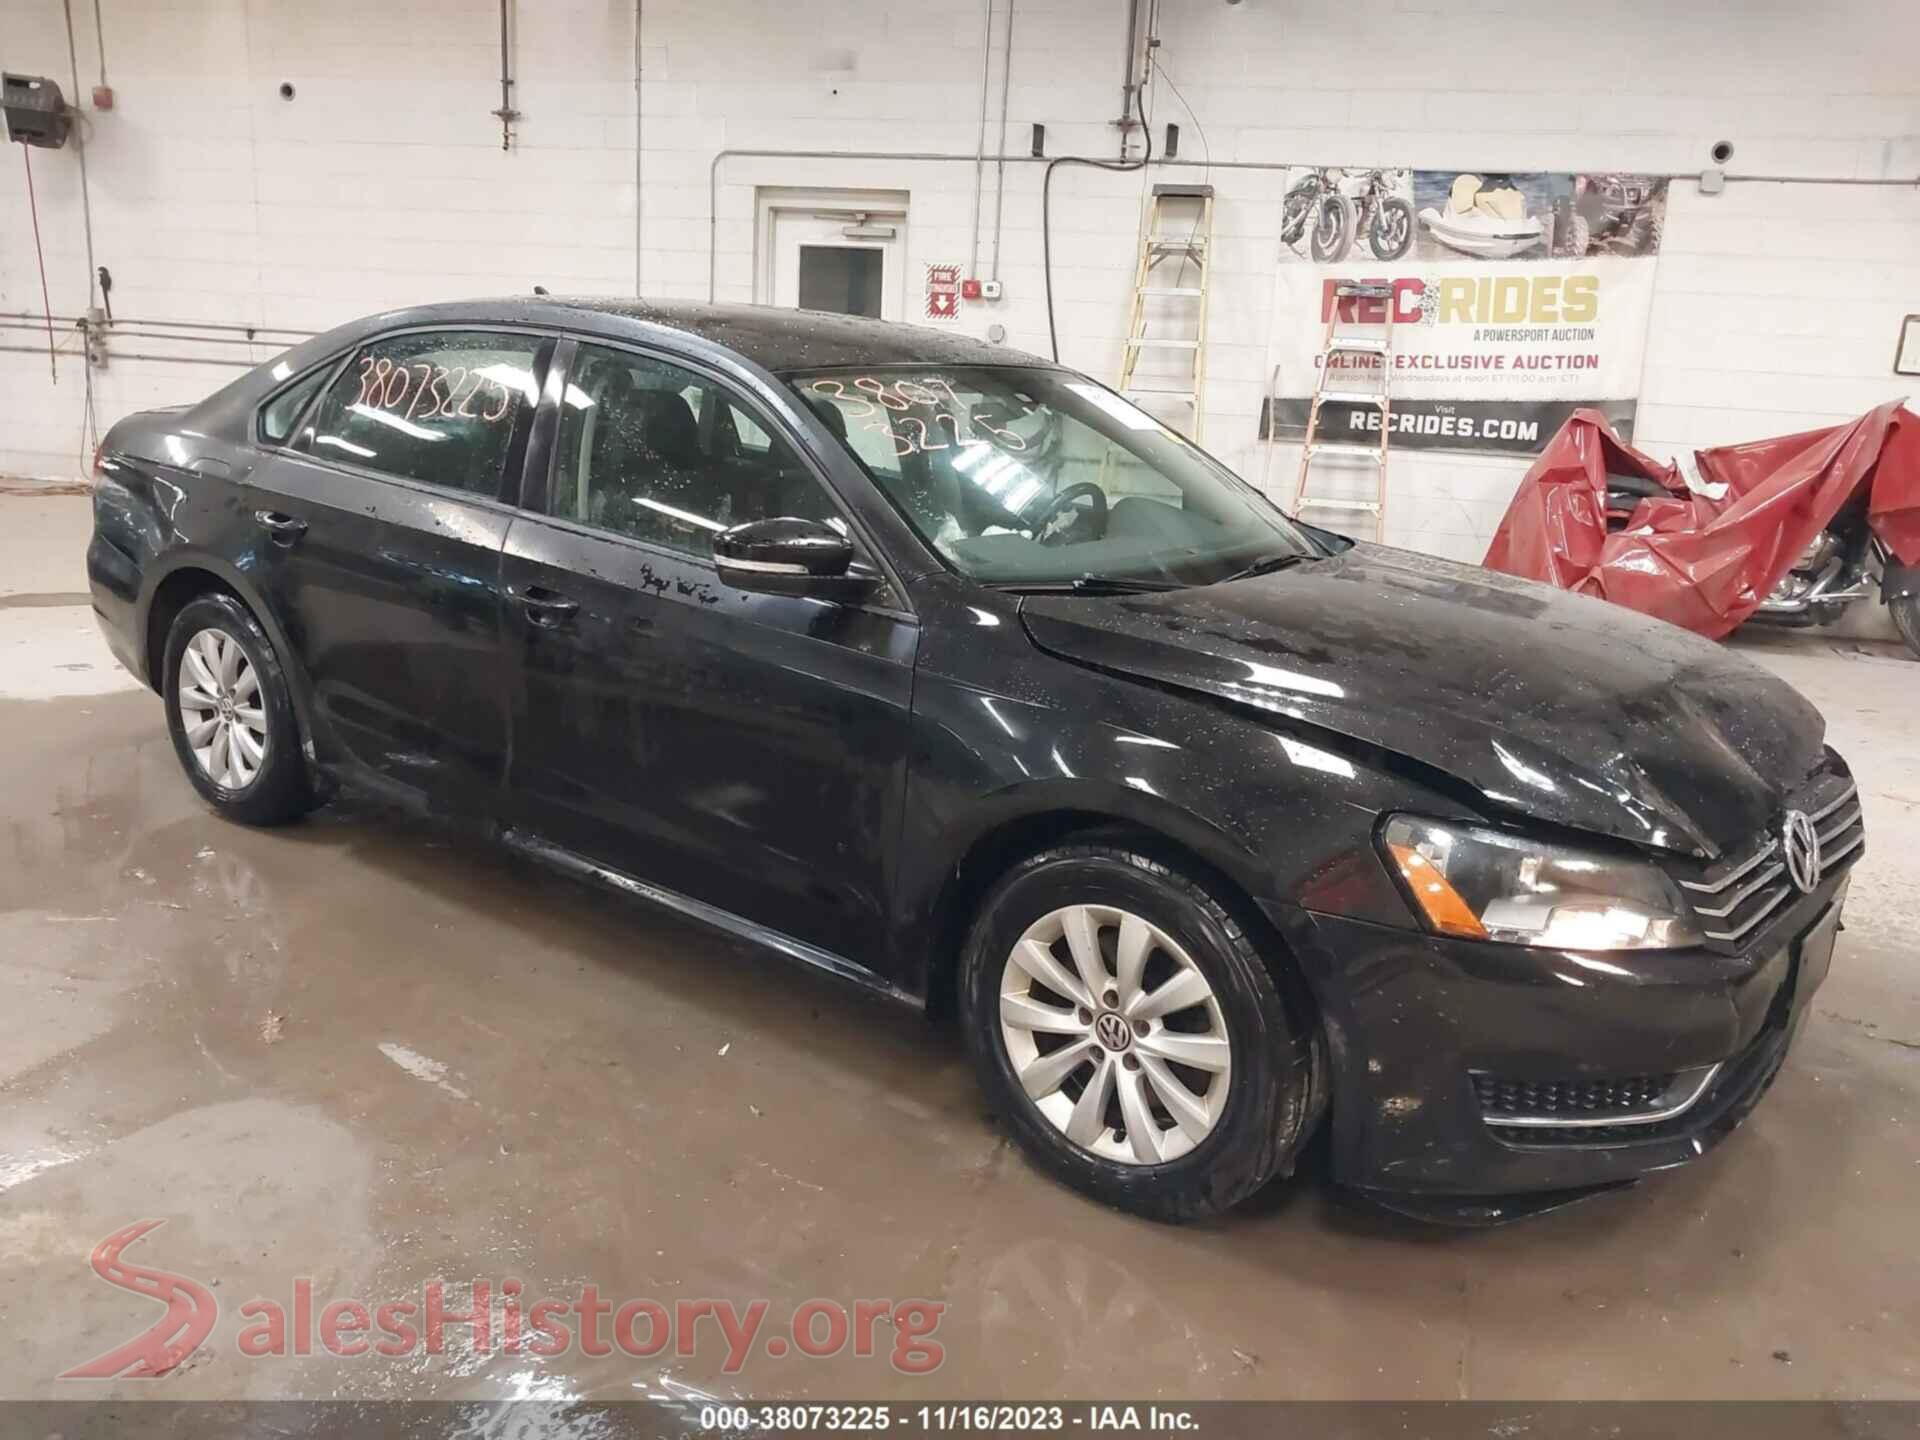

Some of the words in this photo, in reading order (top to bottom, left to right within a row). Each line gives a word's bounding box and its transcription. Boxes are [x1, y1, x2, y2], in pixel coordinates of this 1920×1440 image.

[1321, 278, 1425, 324] REC
[1438, 276, 1600, 324] RIDES
[1473, 329, 1481, 341] A
[1483, 328, 1550, 341] POWERSPORT
[1552, 328, 1595, 341] AUCTION
[1511, 353, 1599, 370] AUCTION
[354, 357, 510, 421] 38073225
[811, 377, 968, 417] 3807
[1435, 404, 1455, 414] Visit
[1350, 410, 1539, 441] RECRIDES.COM
